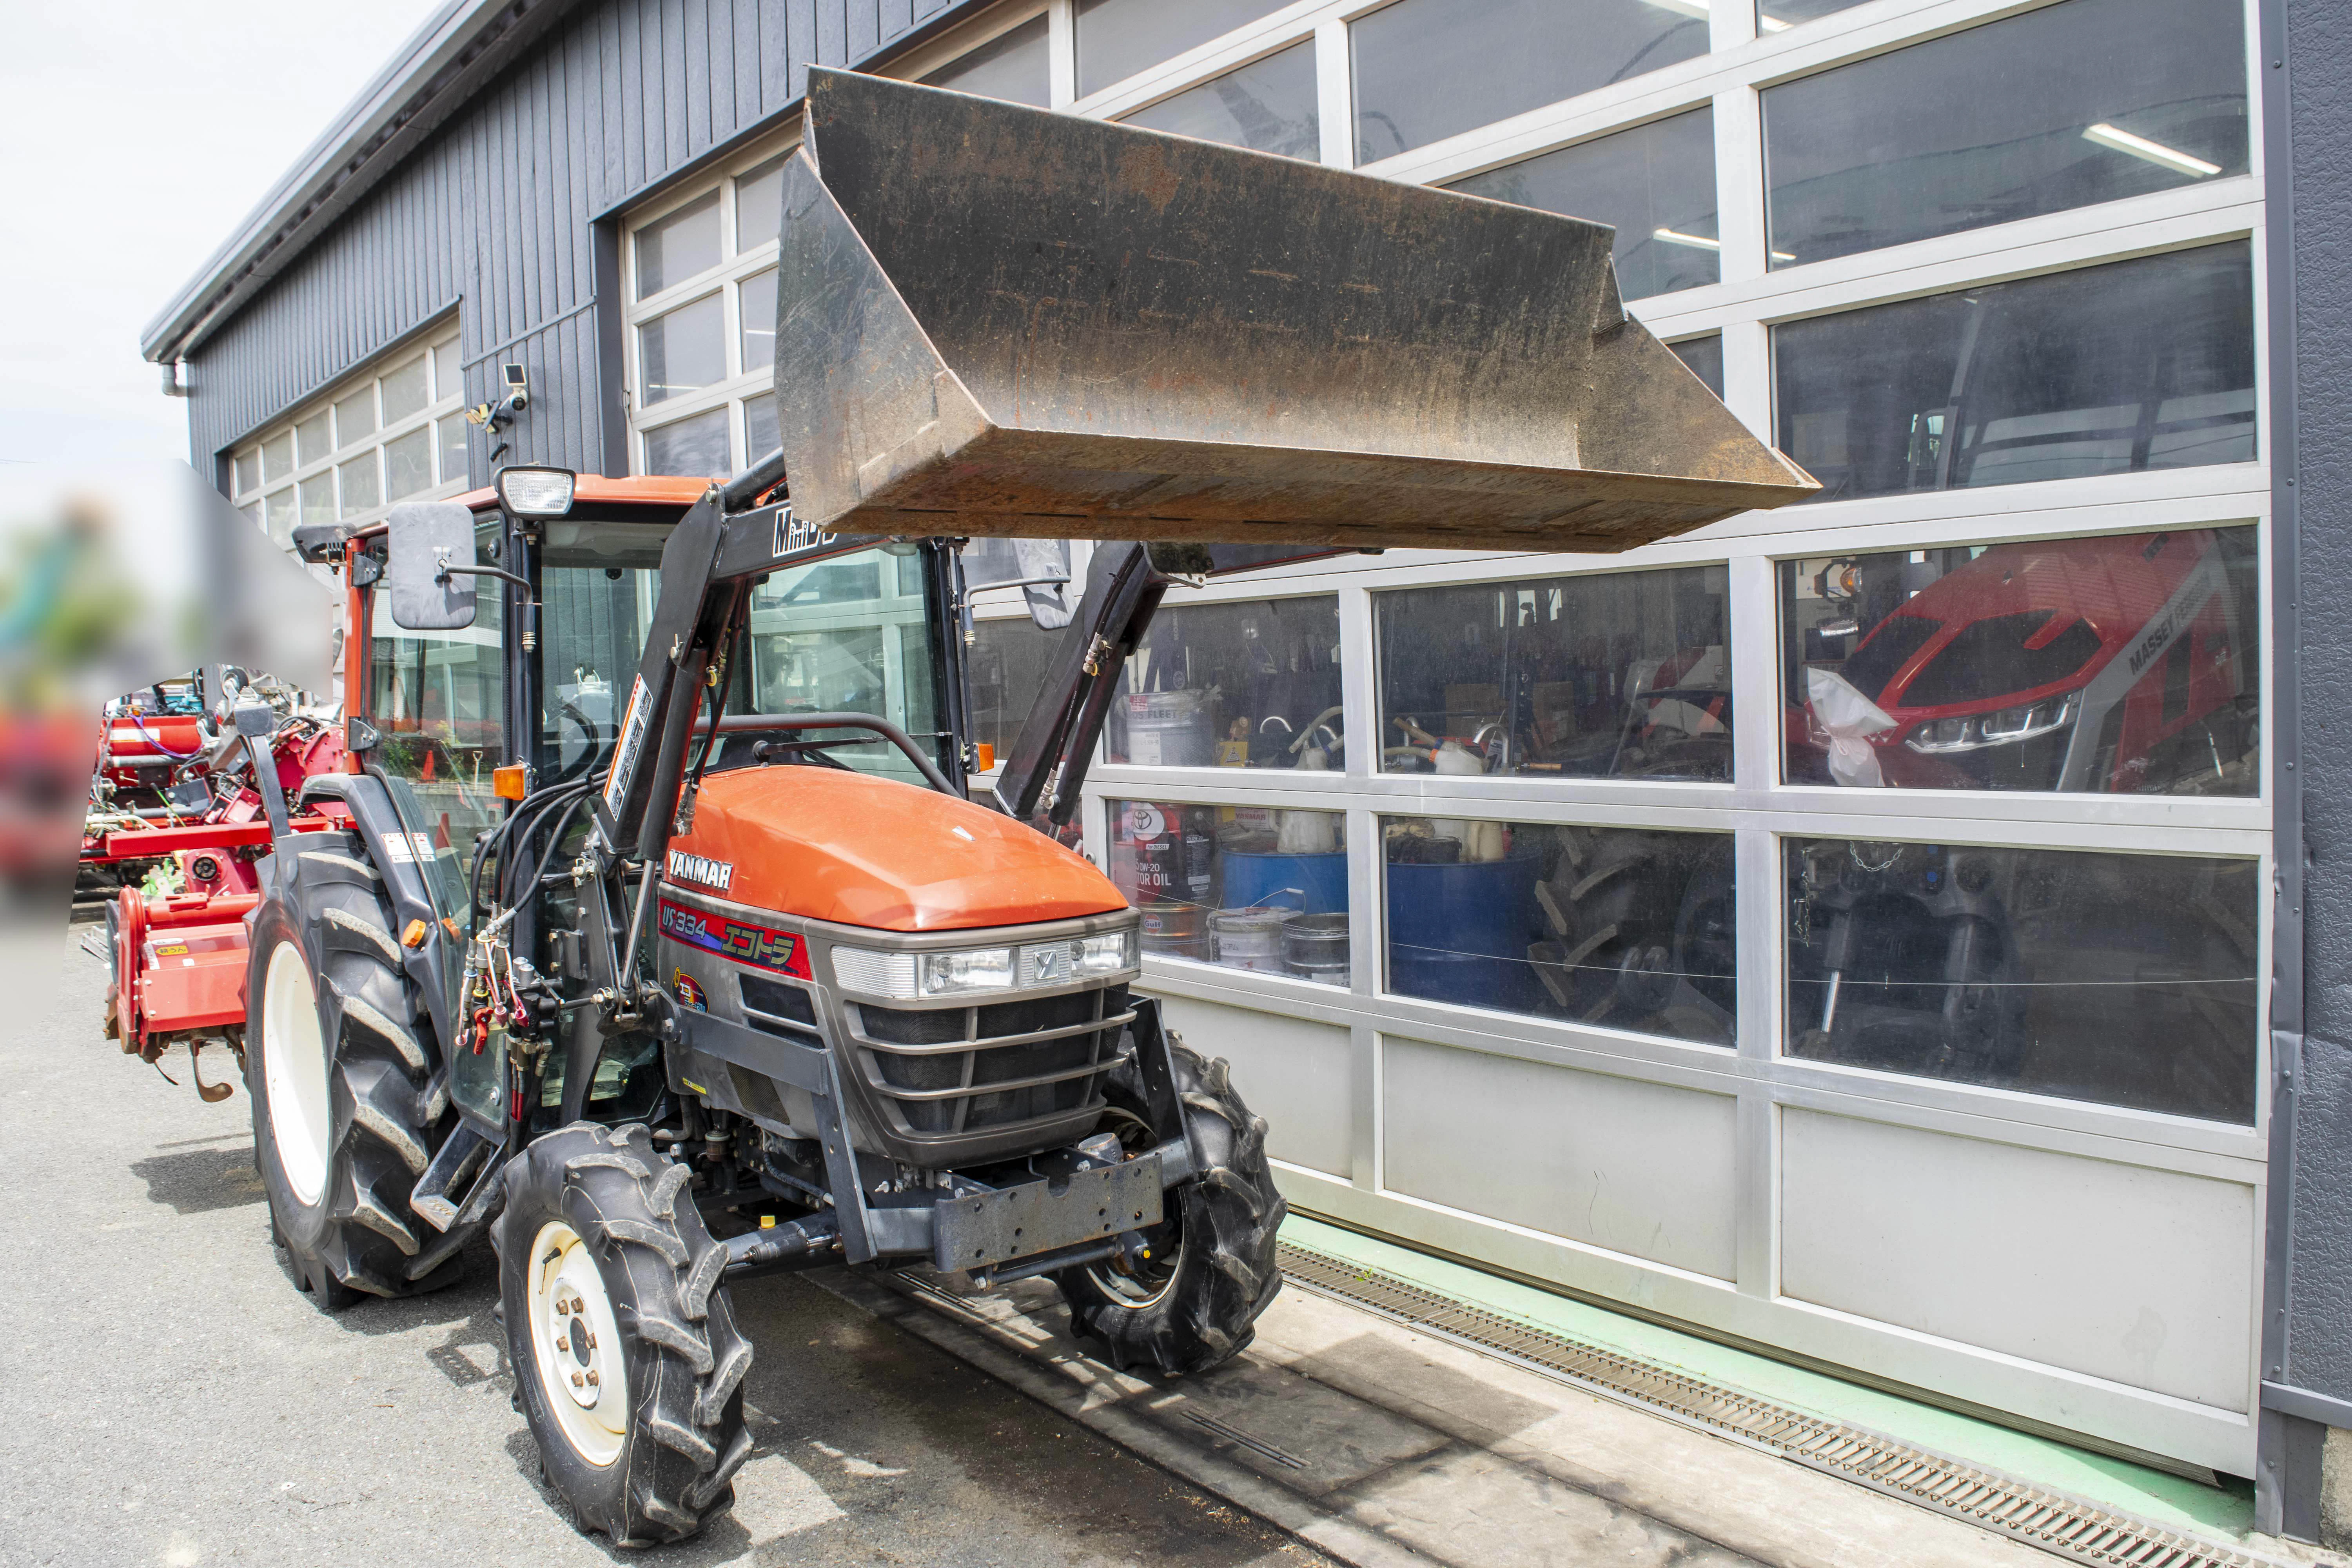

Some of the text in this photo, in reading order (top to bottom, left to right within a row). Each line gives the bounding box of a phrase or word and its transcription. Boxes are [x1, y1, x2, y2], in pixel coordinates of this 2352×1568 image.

[2129, 614, 2174, 675] MASSEY
[669, 849, 733, 890] YANMAR
[1140, 864, 1160, 872] 0W-20
[1153, 873, 1172, 886] OIL
[722, 925, 794, 965] エコトラ
[680, 982, 691, 998] エコ
